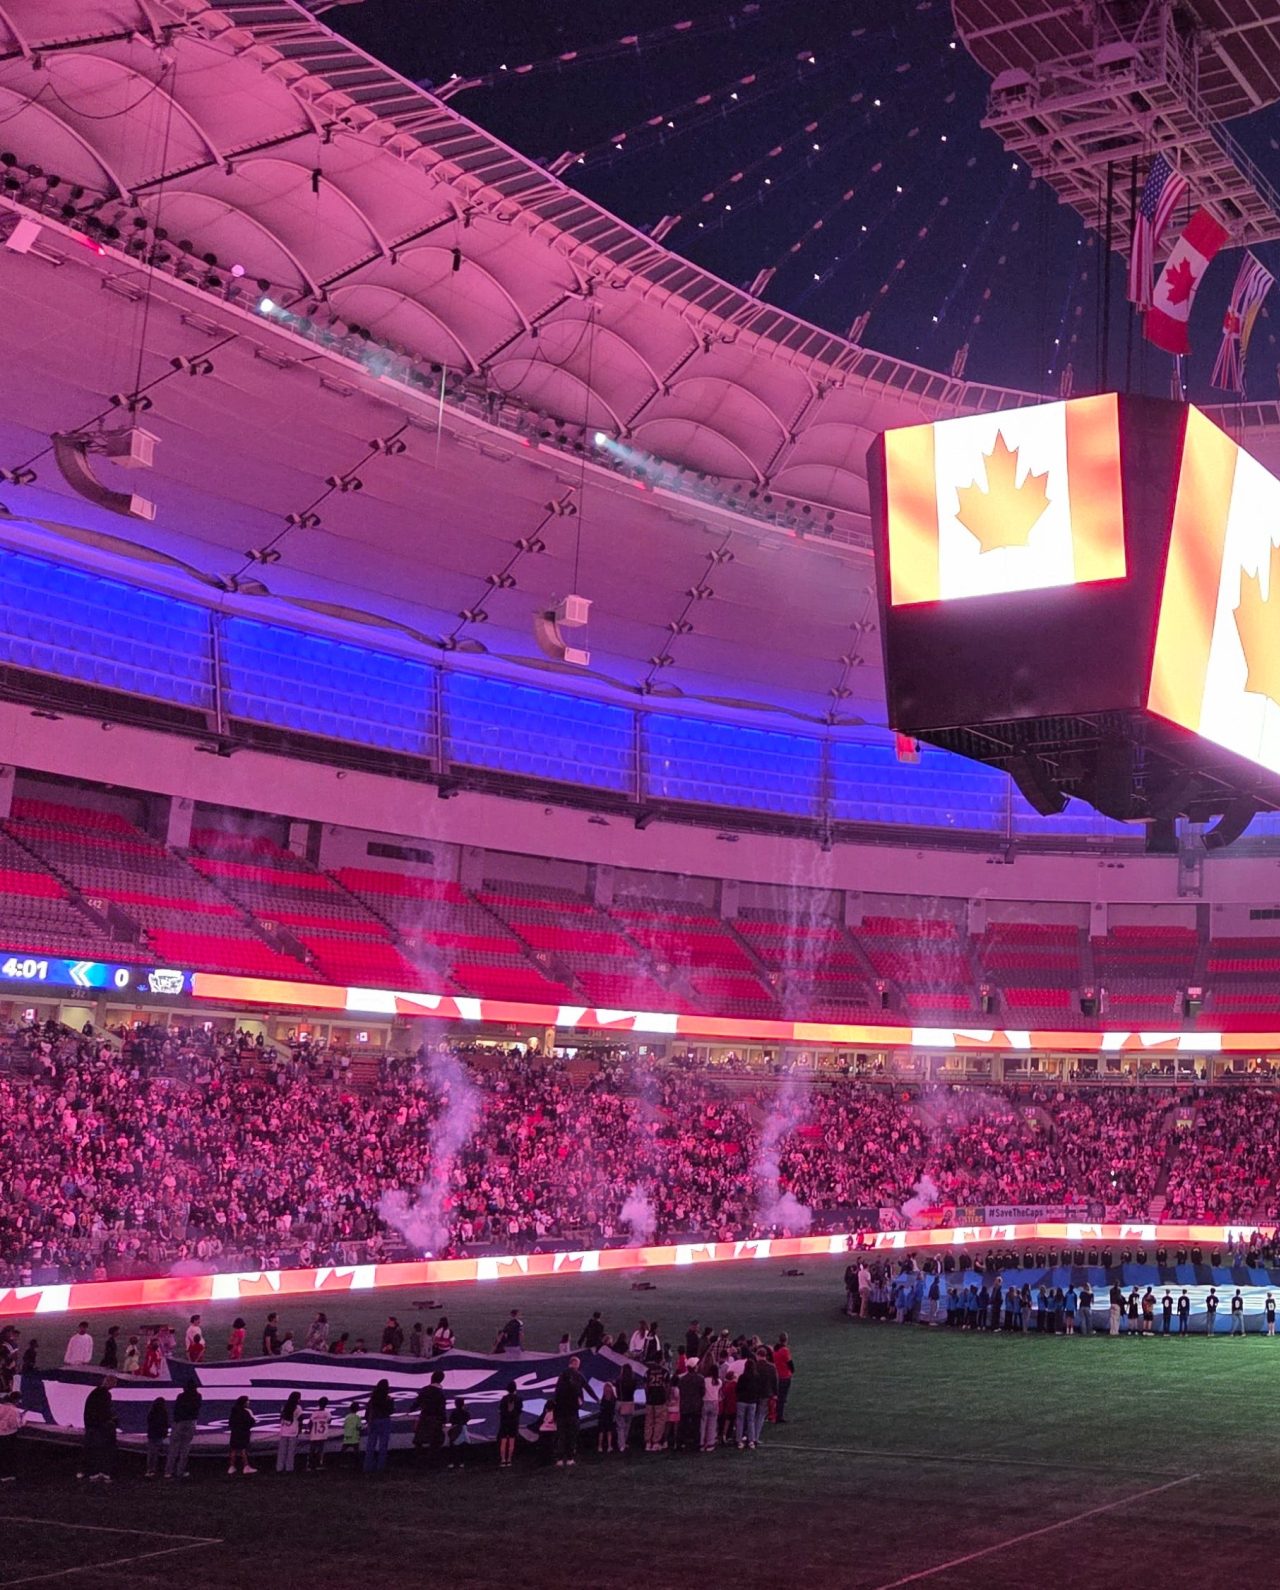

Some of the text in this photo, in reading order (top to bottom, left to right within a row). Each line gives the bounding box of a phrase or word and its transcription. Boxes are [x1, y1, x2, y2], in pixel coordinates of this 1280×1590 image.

[2, 958, 49, 981] 4:01
[115, 968, 130, 987] 0
[989, 1207, 1044, 1218] #SaveTheCaps
[650, 1375, 663, 1386] 25
[314, 1420, 326, 1434] 13
